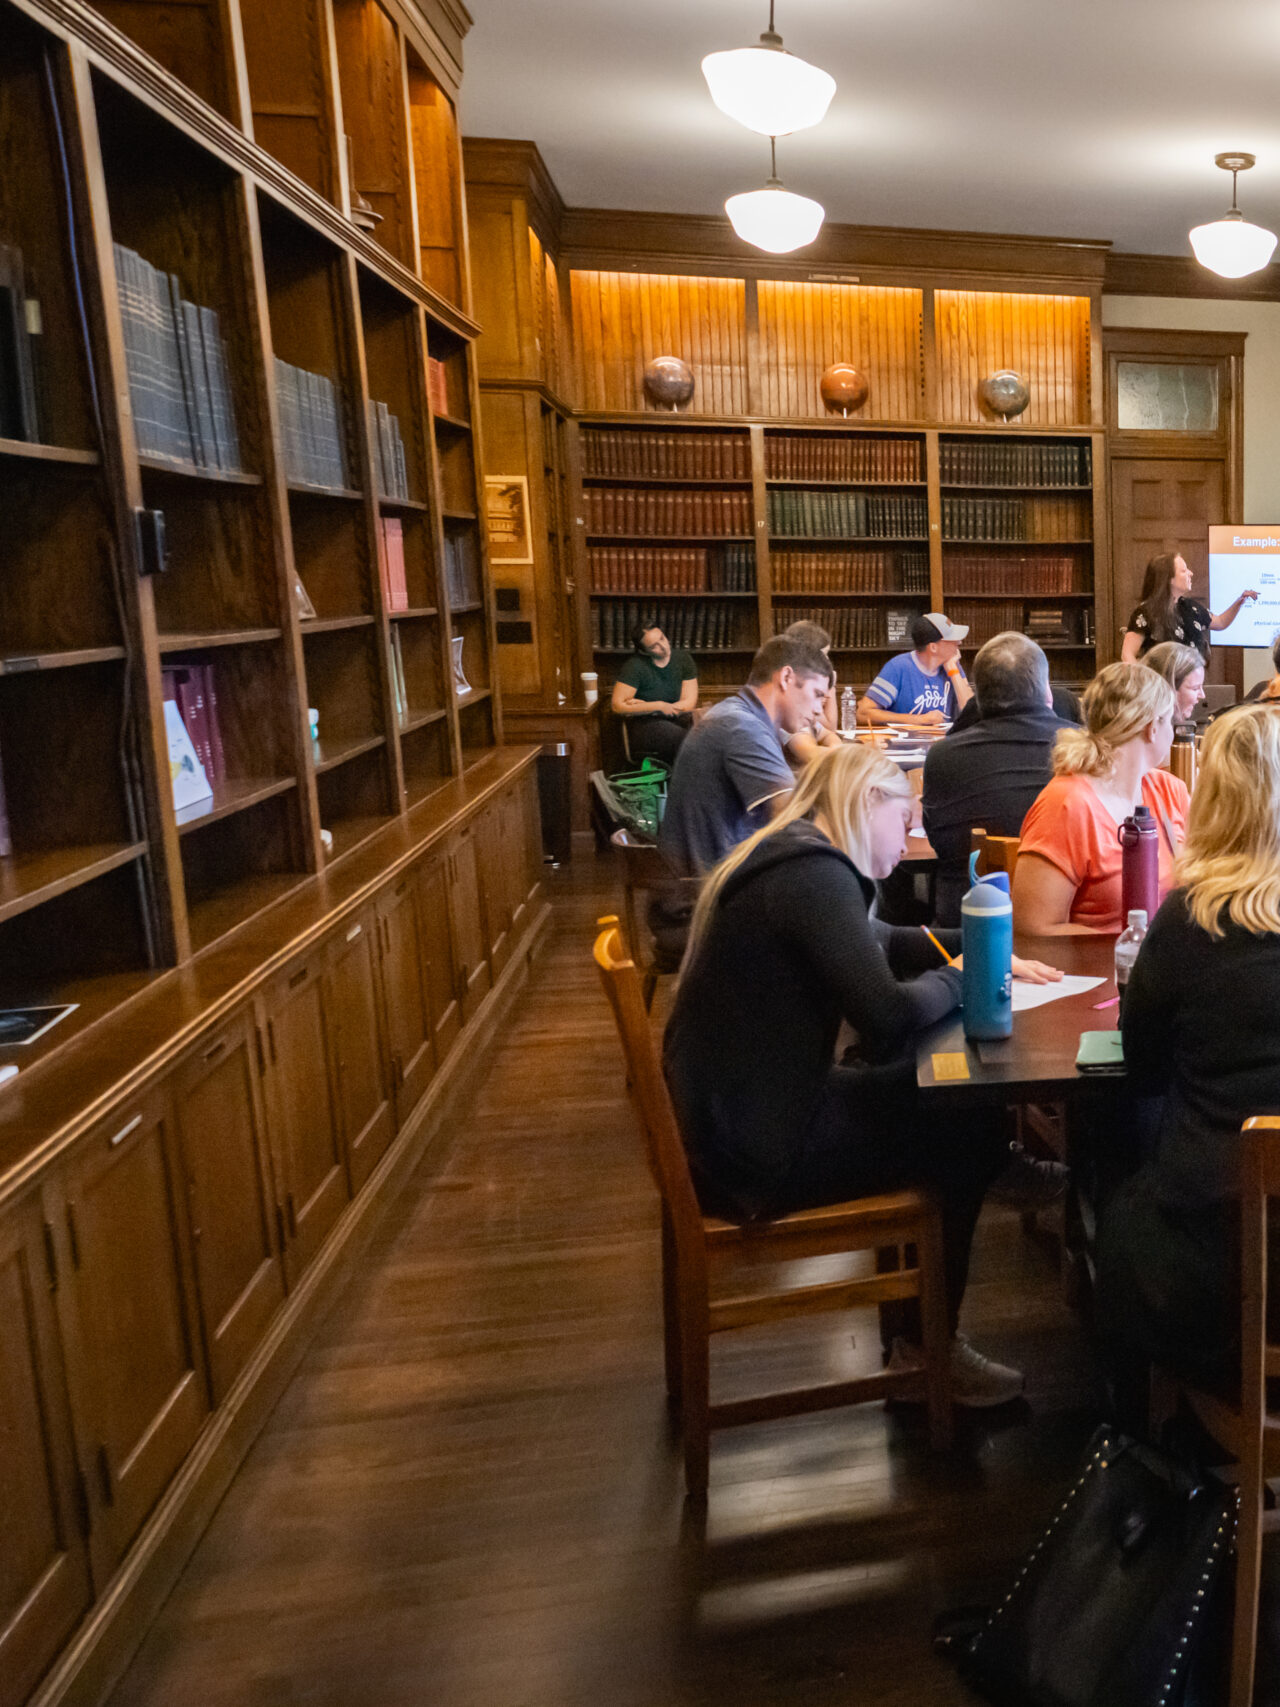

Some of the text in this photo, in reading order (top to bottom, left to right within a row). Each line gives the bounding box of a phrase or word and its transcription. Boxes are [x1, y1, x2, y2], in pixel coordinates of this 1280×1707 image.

[757, 520, 765, 528] 17
[1233, 535, 1280, 549] Example:
[909, 681, 951, 715] good
